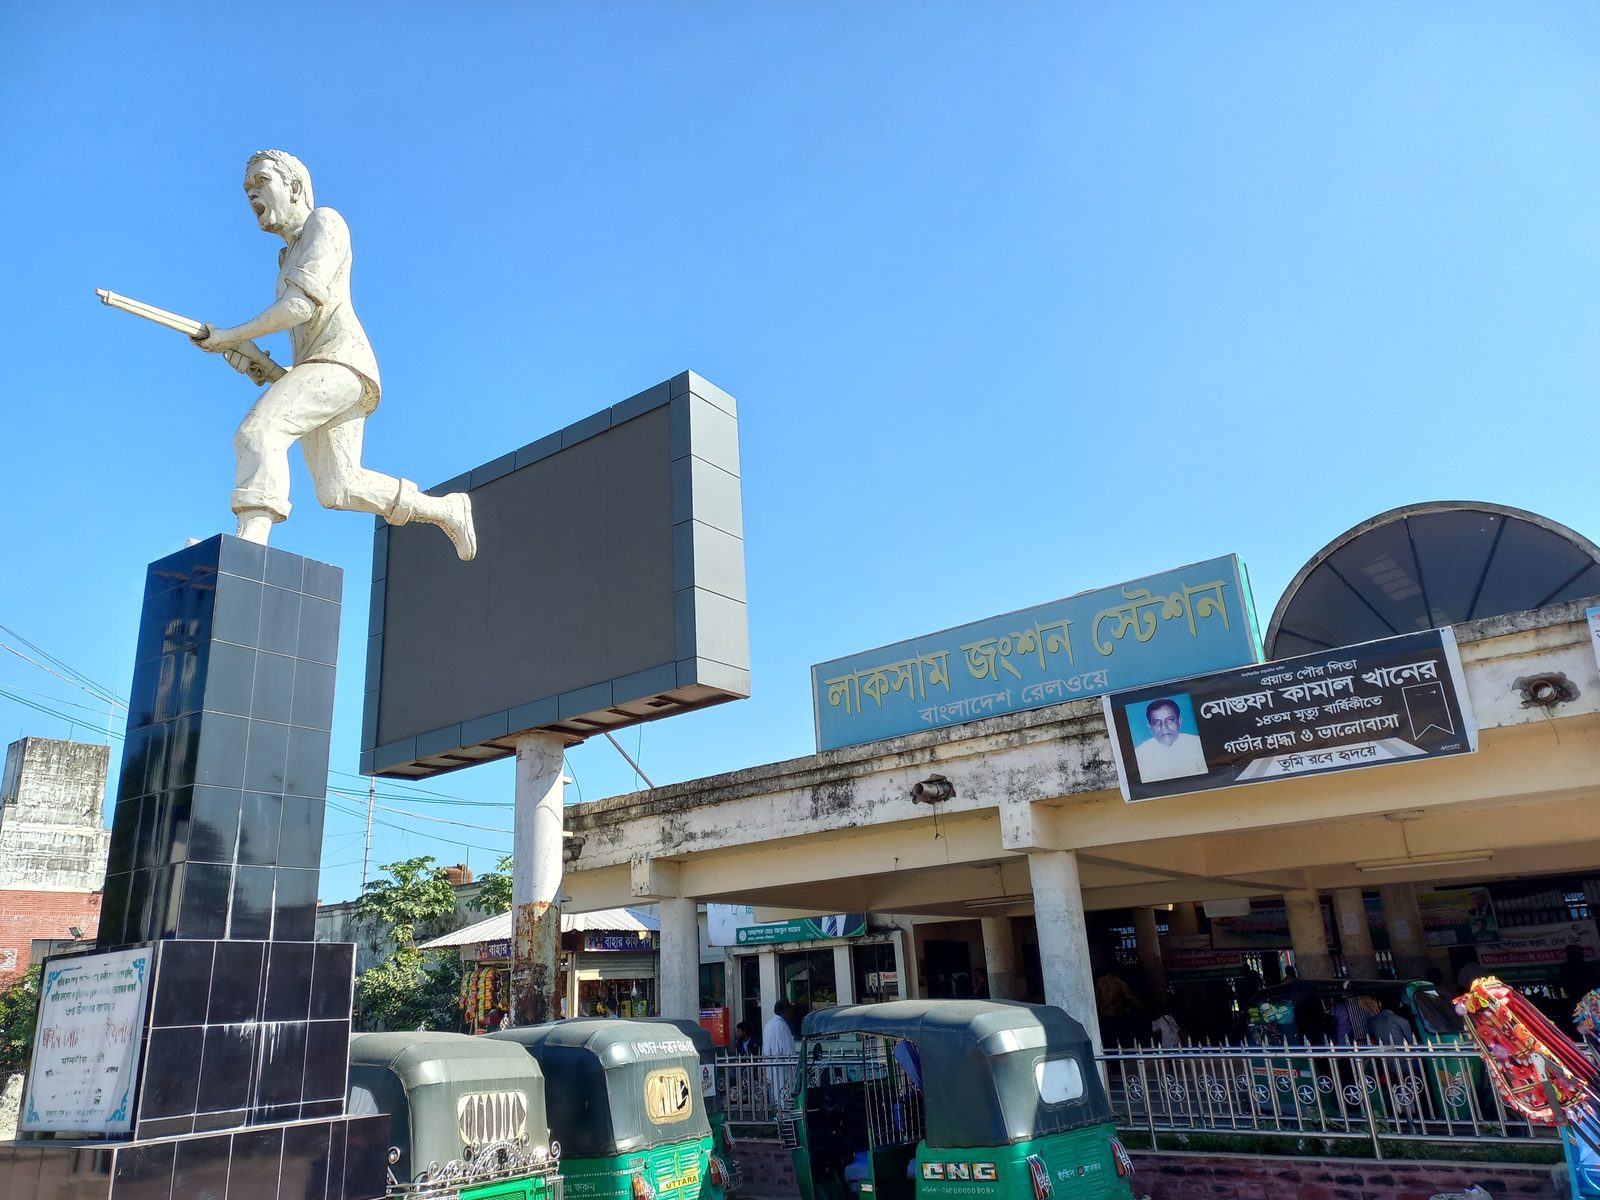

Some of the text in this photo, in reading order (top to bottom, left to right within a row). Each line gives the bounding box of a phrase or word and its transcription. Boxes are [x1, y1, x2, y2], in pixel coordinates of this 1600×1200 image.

[824, 578, 1231, 716] লাকসাম জংশন স্টেশন
[1260, 656, 1359, 686] প্রয়াত পৌর পিতা
[918, 669, 1112, 724] বাংলাদেশ রেলওয়ে
[1200, 658, 1439, 720] মোস্তফা কামাল খানের
[1255, 694, 1384, 729] ১৪তম মৃত্যু বার্ষিকীতে
[1223, 712, 1400, 755] গভীর শ্রদ্ধা ও ভালোবাসা
[1276, 744, 1378, 774] তুমি রবে হৃদয়ে
[488, 943, 508, 958] বাহার
[666, 1175, 698, 1189] UTTARA
[921, 1162, 999, 1180] CNG
